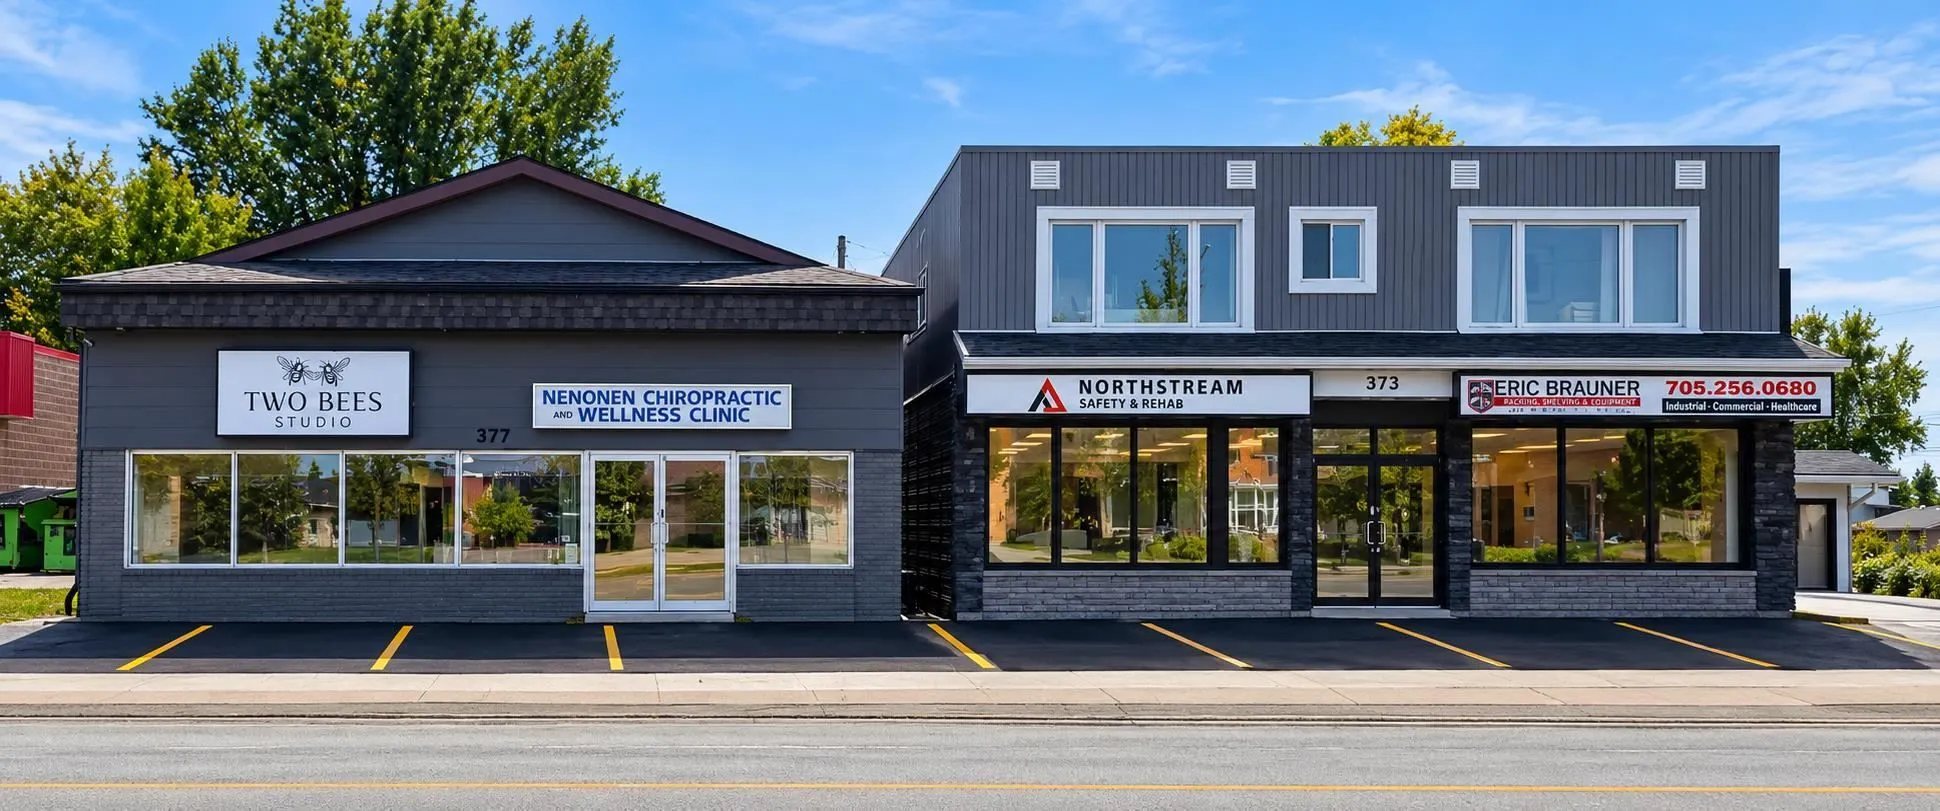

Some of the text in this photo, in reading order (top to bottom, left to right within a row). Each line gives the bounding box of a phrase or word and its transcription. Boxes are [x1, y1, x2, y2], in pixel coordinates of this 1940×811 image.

[1079, 379, 1243, 395] NORTHSTREAM
[1366, 375, 1400, 390] 373
[1495, 380, 1640, 396] ERIC BRAUNER
[1665, 380, 1817, 396] 705.256.0680
[244, 391, 382, 412] TWO BEES
[542, 390, 782, 406] NENONEN CHIROPRACTIC
[1079, 398, 1184, 409] SAFETY & REHAB
[1665, 401, 1818, 412] Industrial Commercial Healthcare
[275, 416, 352, 428] STUDIO
[553, 407, 750, 423] AND WELLNESS CLINIC
[476, 428, 511, 443] 377
